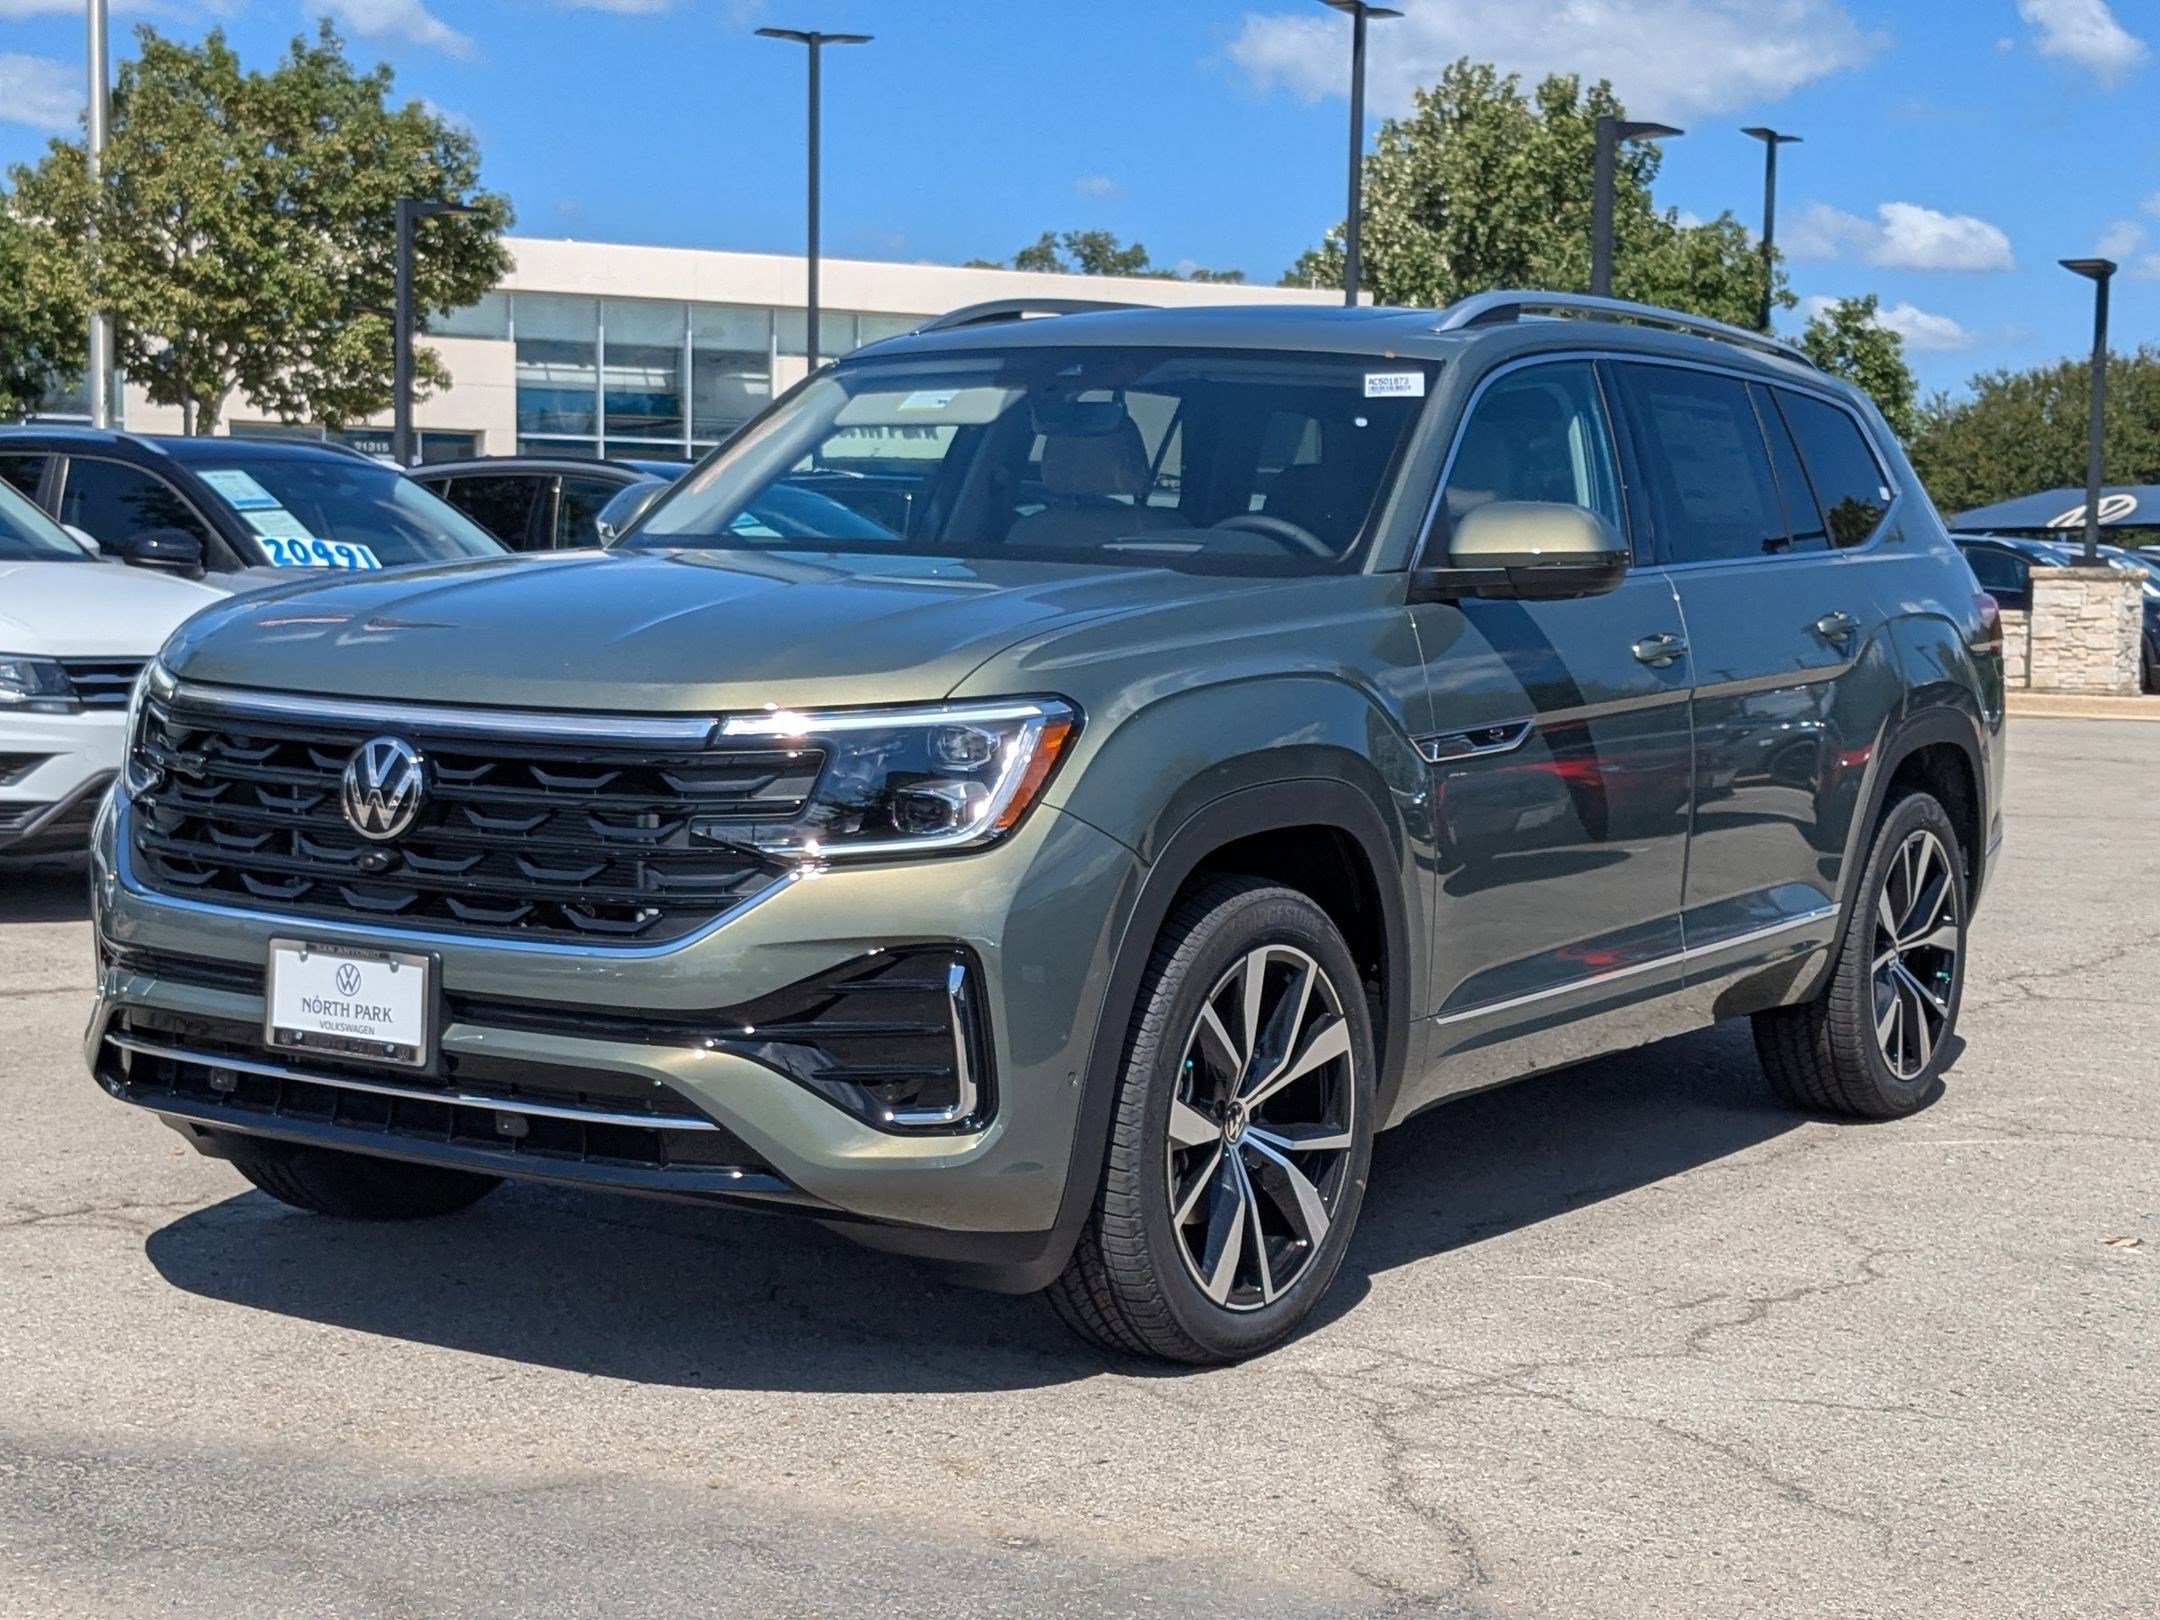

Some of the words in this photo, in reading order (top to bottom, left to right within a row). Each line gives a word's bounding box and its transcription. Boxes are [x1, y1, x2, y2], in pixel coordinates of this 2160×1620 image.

[302, 996, 350, 1018] NORTH
[355, 1004, 393, 1023] PARK
[319, 1021, 375, 1035] VOLKSWAGEN
